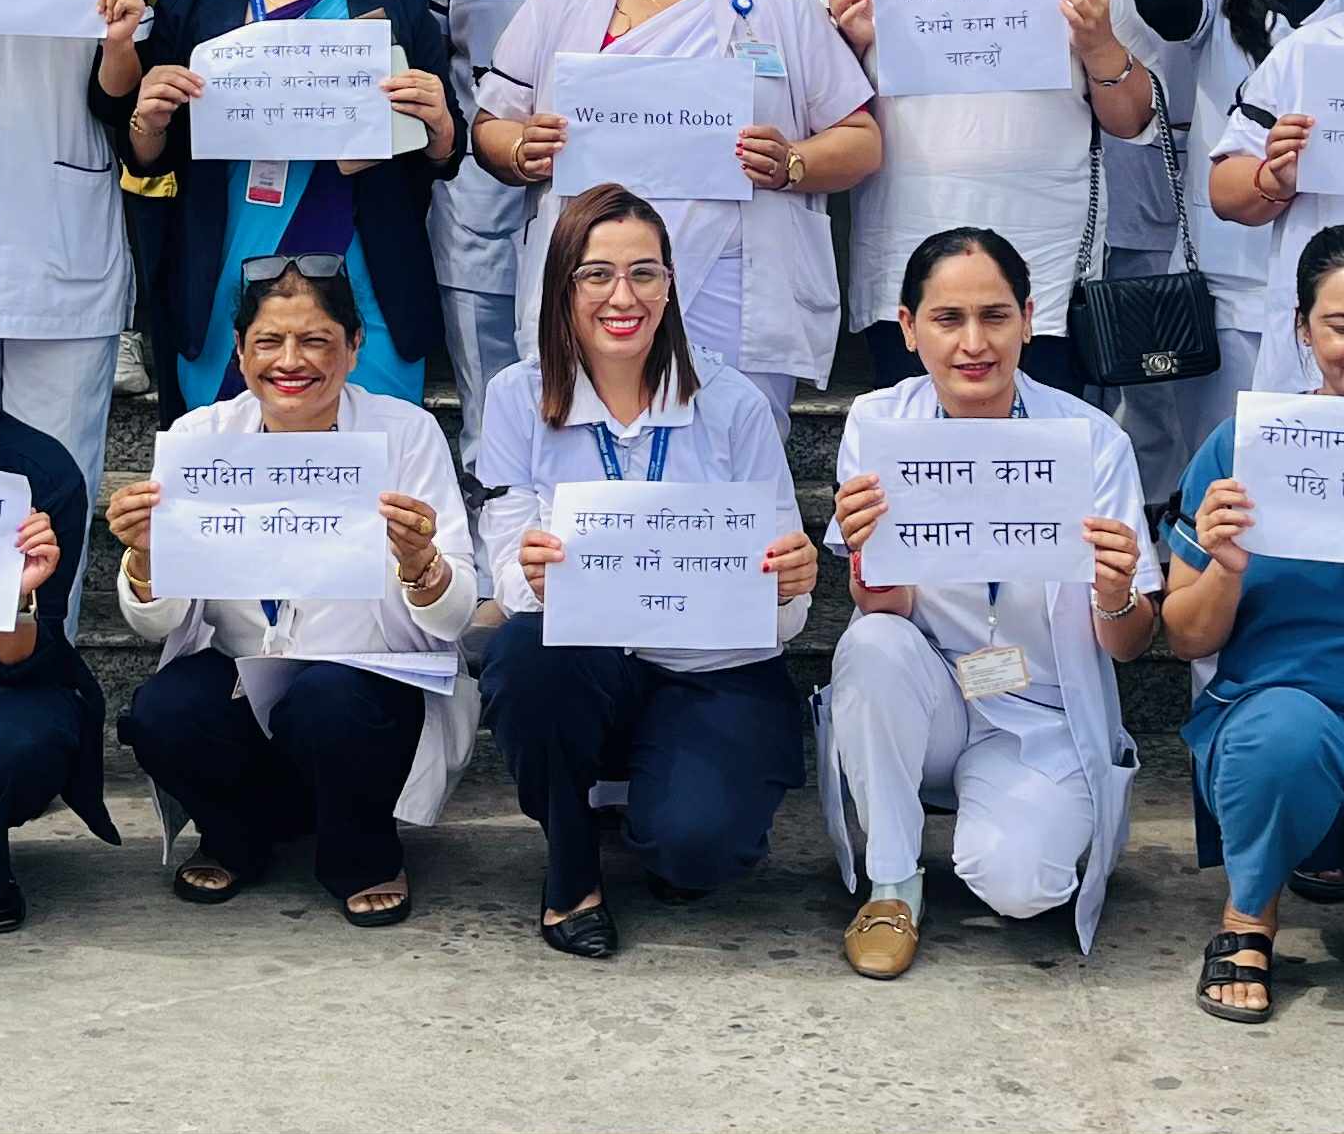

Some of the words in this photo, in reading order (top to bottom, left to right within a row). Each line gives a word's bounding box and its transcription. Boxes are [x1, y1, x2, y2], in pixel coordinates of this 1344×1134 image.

[914, 11, 954, 35] देशमै
[961, 17, 997, 32] काम
[1003, 9, 1030, 30] गर्न
[261, 44, 313, 59] स्वास्थ्य
[280, 70, 342, 90] आन्दोलन
[344, 70, 373, 89] प्रति
[291, 101, 337, 120] समर्थन
[340, 105, 360, 123] छ
[575, 107, 606, 123] We
[608, 111, 639, 125] are
[643, 110, 674, 125] not
[679, 109, 733, 128] Robot
[180, 458, 256, 495] सुरक्षित
[266, 458, 362, 486] कार्यस्थल
[896, 460, 977, 487] समान
[991, 459, 1057, 485] काम
[1284, 467, 1329, 501] पछि
[260, 506, 343, 536] अधिकार
[574, 512, 636, 536] मुस्कान
[645, 507, 716, 531] सहितको
[723, 507, 757, 530] सेवा
[894, 521, 975, 548] समान
[578, 554, 625, 571] प्रवाह
[671, 555, 749, 573] वातावरण
